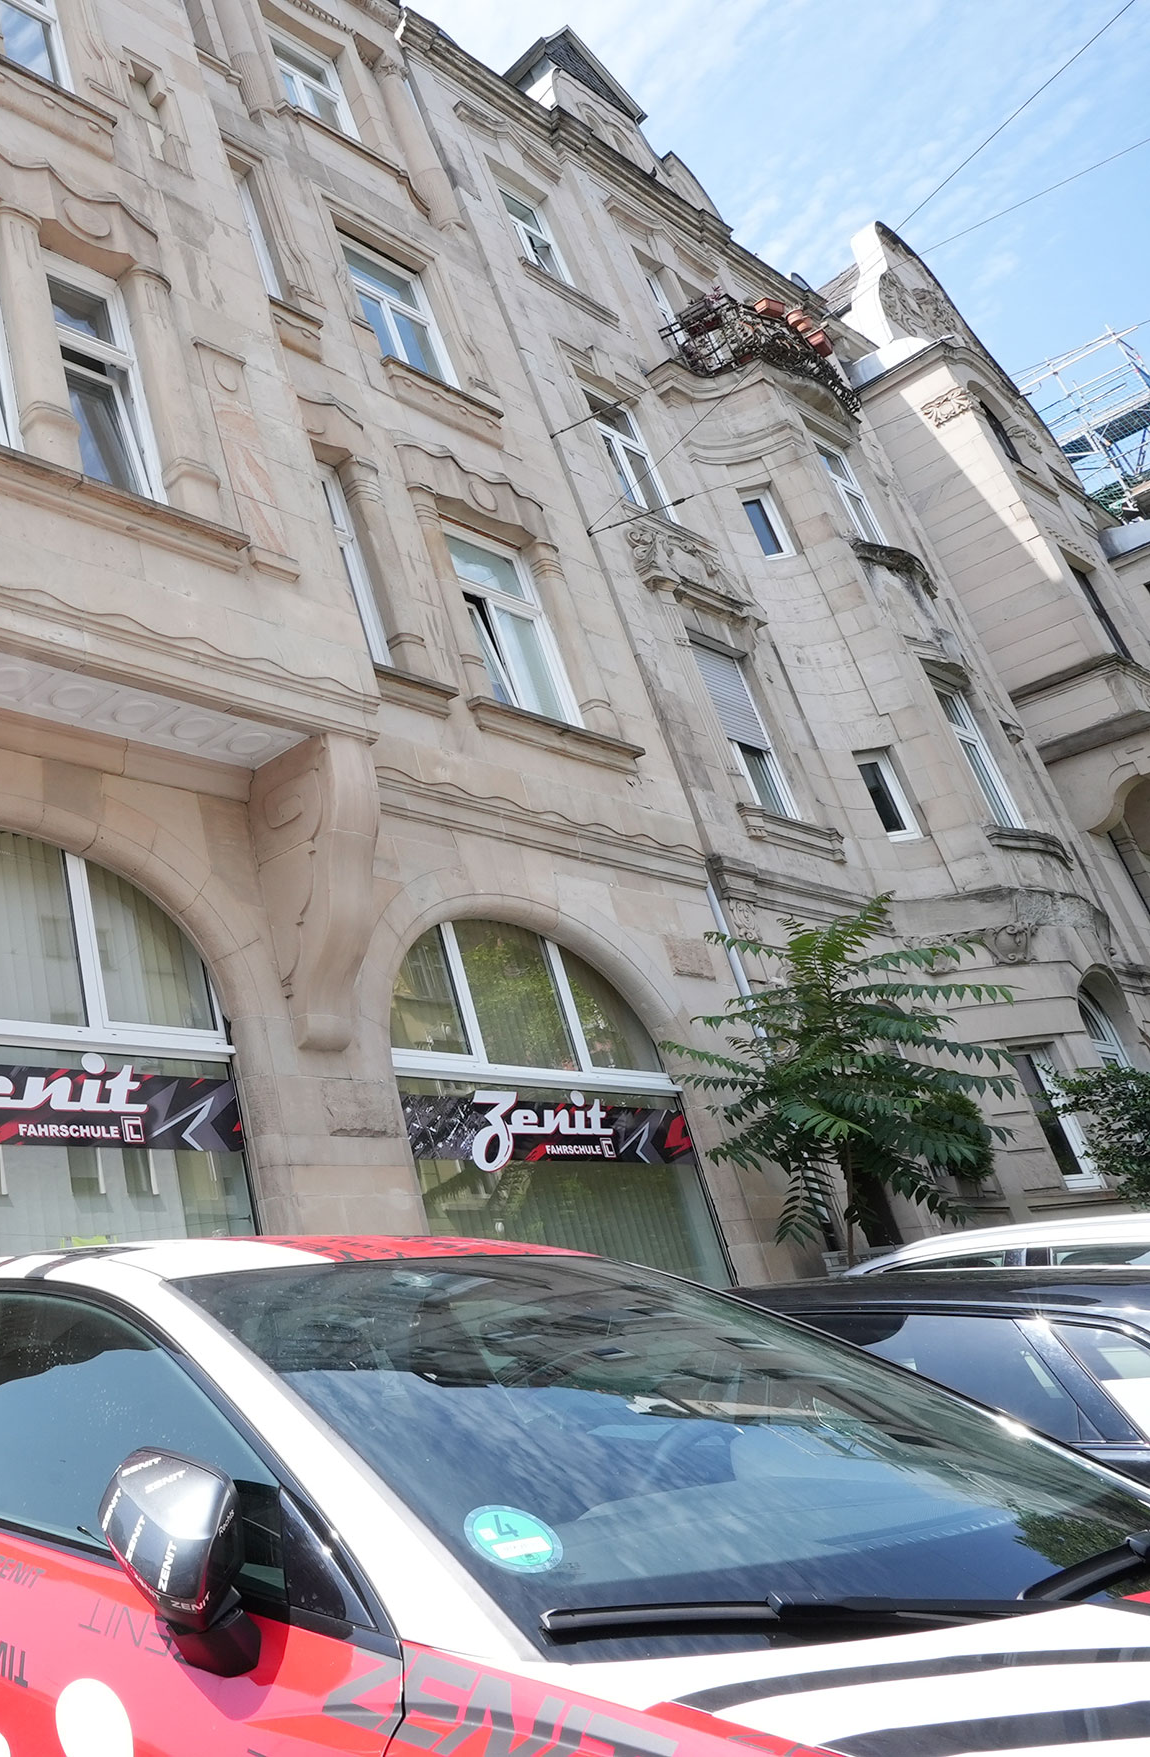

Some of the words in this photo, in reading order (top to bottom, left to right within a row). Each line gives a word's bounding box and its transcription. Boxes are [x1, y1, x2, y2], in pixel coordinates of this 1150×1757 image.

[18, 1122, 120, 1140] FAHRSCHULE
[472, 1090, 613, 1172] Zenit
[545, 1143, 602, 1156] FAHRSCHULE
[122, 1457, 162, 1477] ZENIT
[102, 1487, 122, 1532] ZENIT
[494, 1514, 519, 1537] 4
[125, 1514, 146, 1563] ZENIT
[157, 1540, 178, 1592] ZENIT
[170, 1591, 211, 1614] ZENIT
[322, 1646, 679, 1757] ZENIT
